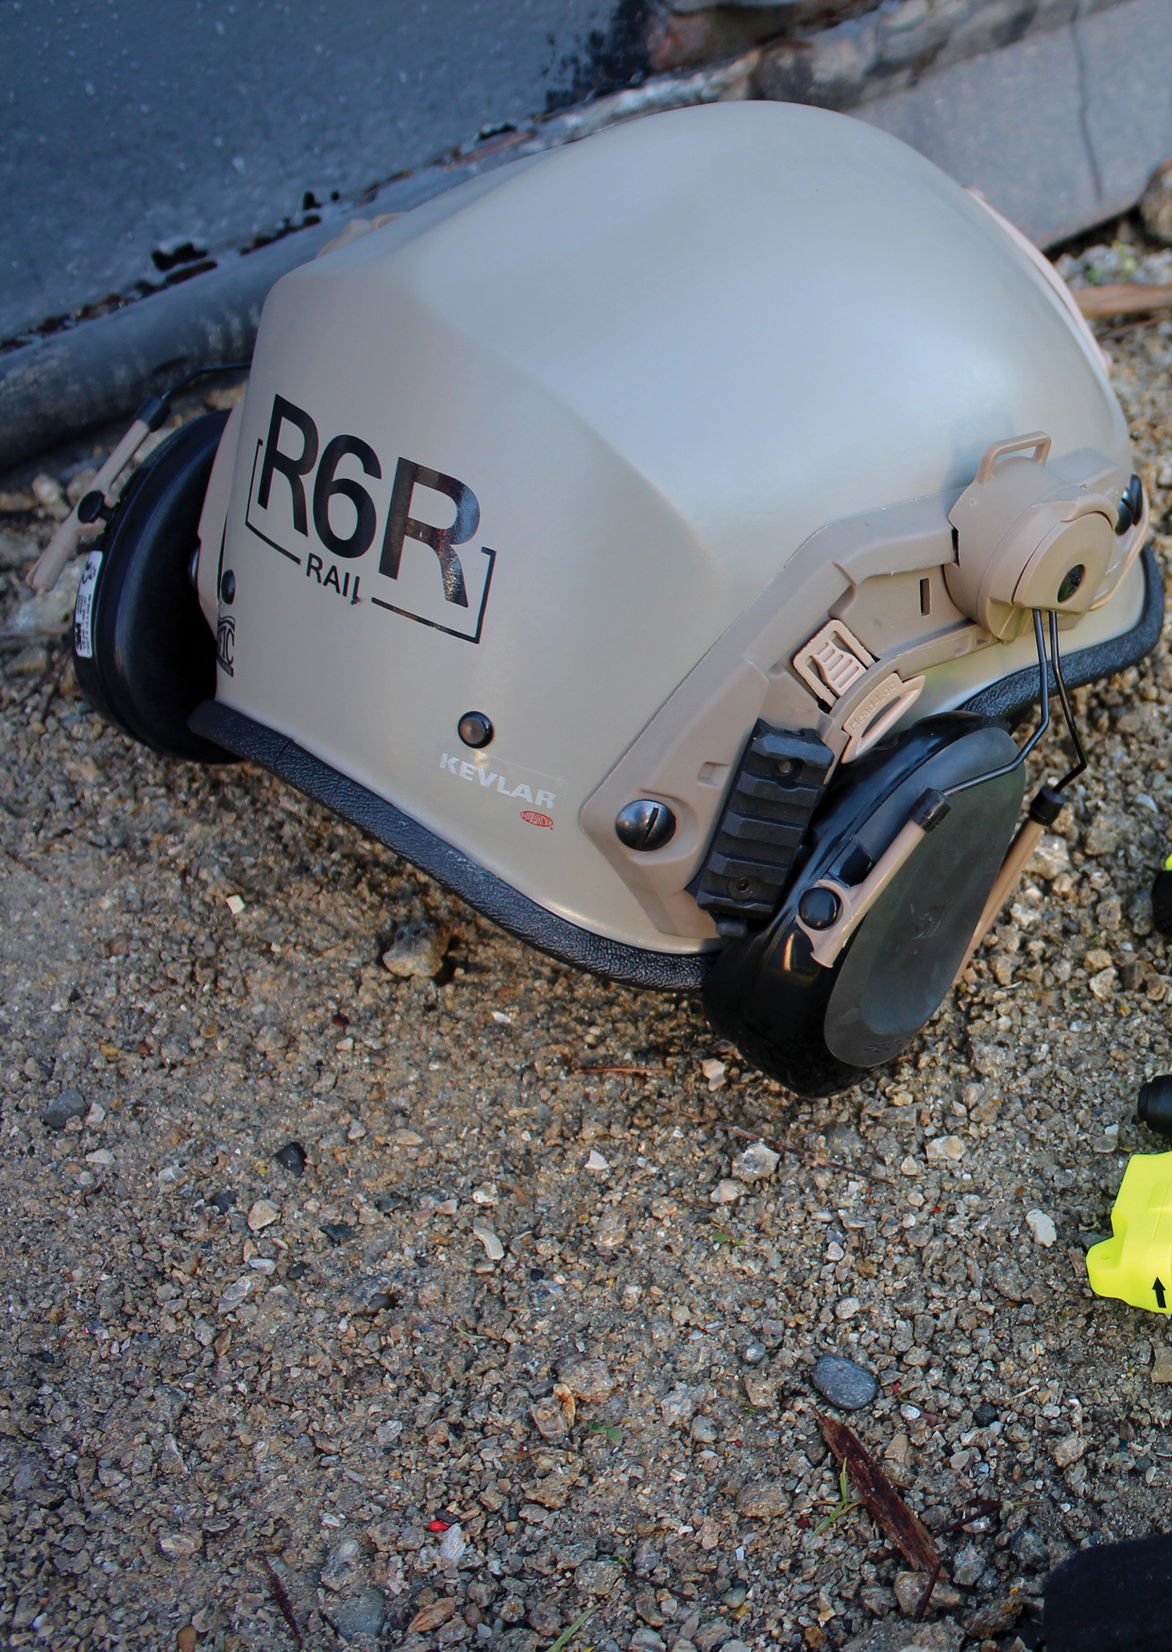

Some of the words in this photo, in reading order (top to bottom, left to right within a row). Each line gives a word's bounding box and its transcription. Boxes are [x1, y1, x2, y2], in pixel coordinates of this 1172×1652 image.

[258, 394, 480, 608] R6R
[306, 552, 361, 605] RAIL
[440, 752, 557, 809] KEVLAR
